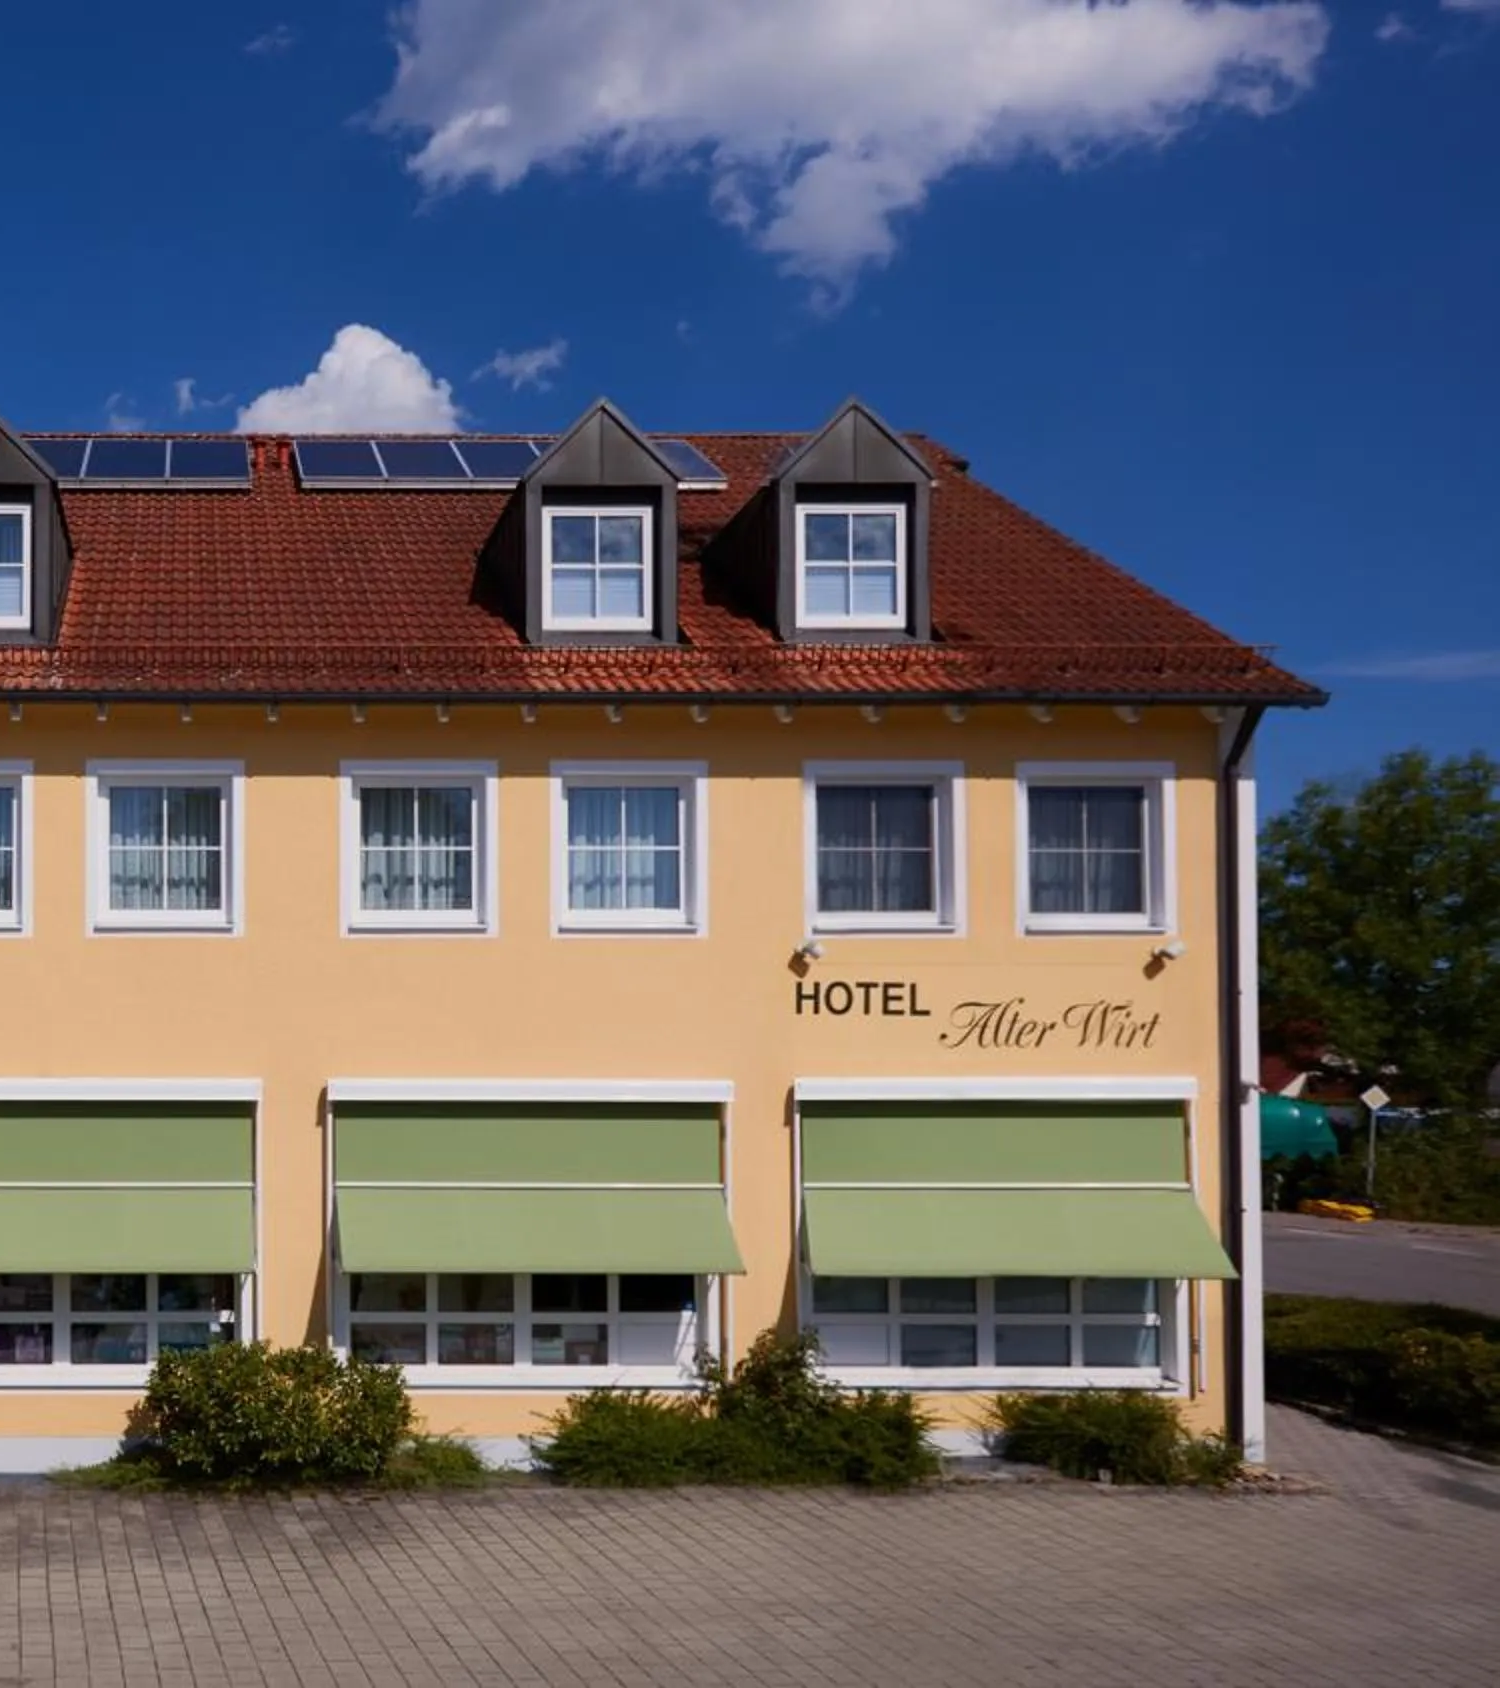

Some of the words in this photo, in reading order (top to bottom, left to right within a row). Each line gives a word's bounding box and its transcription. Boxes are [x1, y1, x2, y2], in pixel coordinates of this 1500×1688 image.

[795, 980, 932, 1017] HOTEL
[938, 997, 1057, 1049] Alter
[1062, 999, 1162, 1049] Wirt
